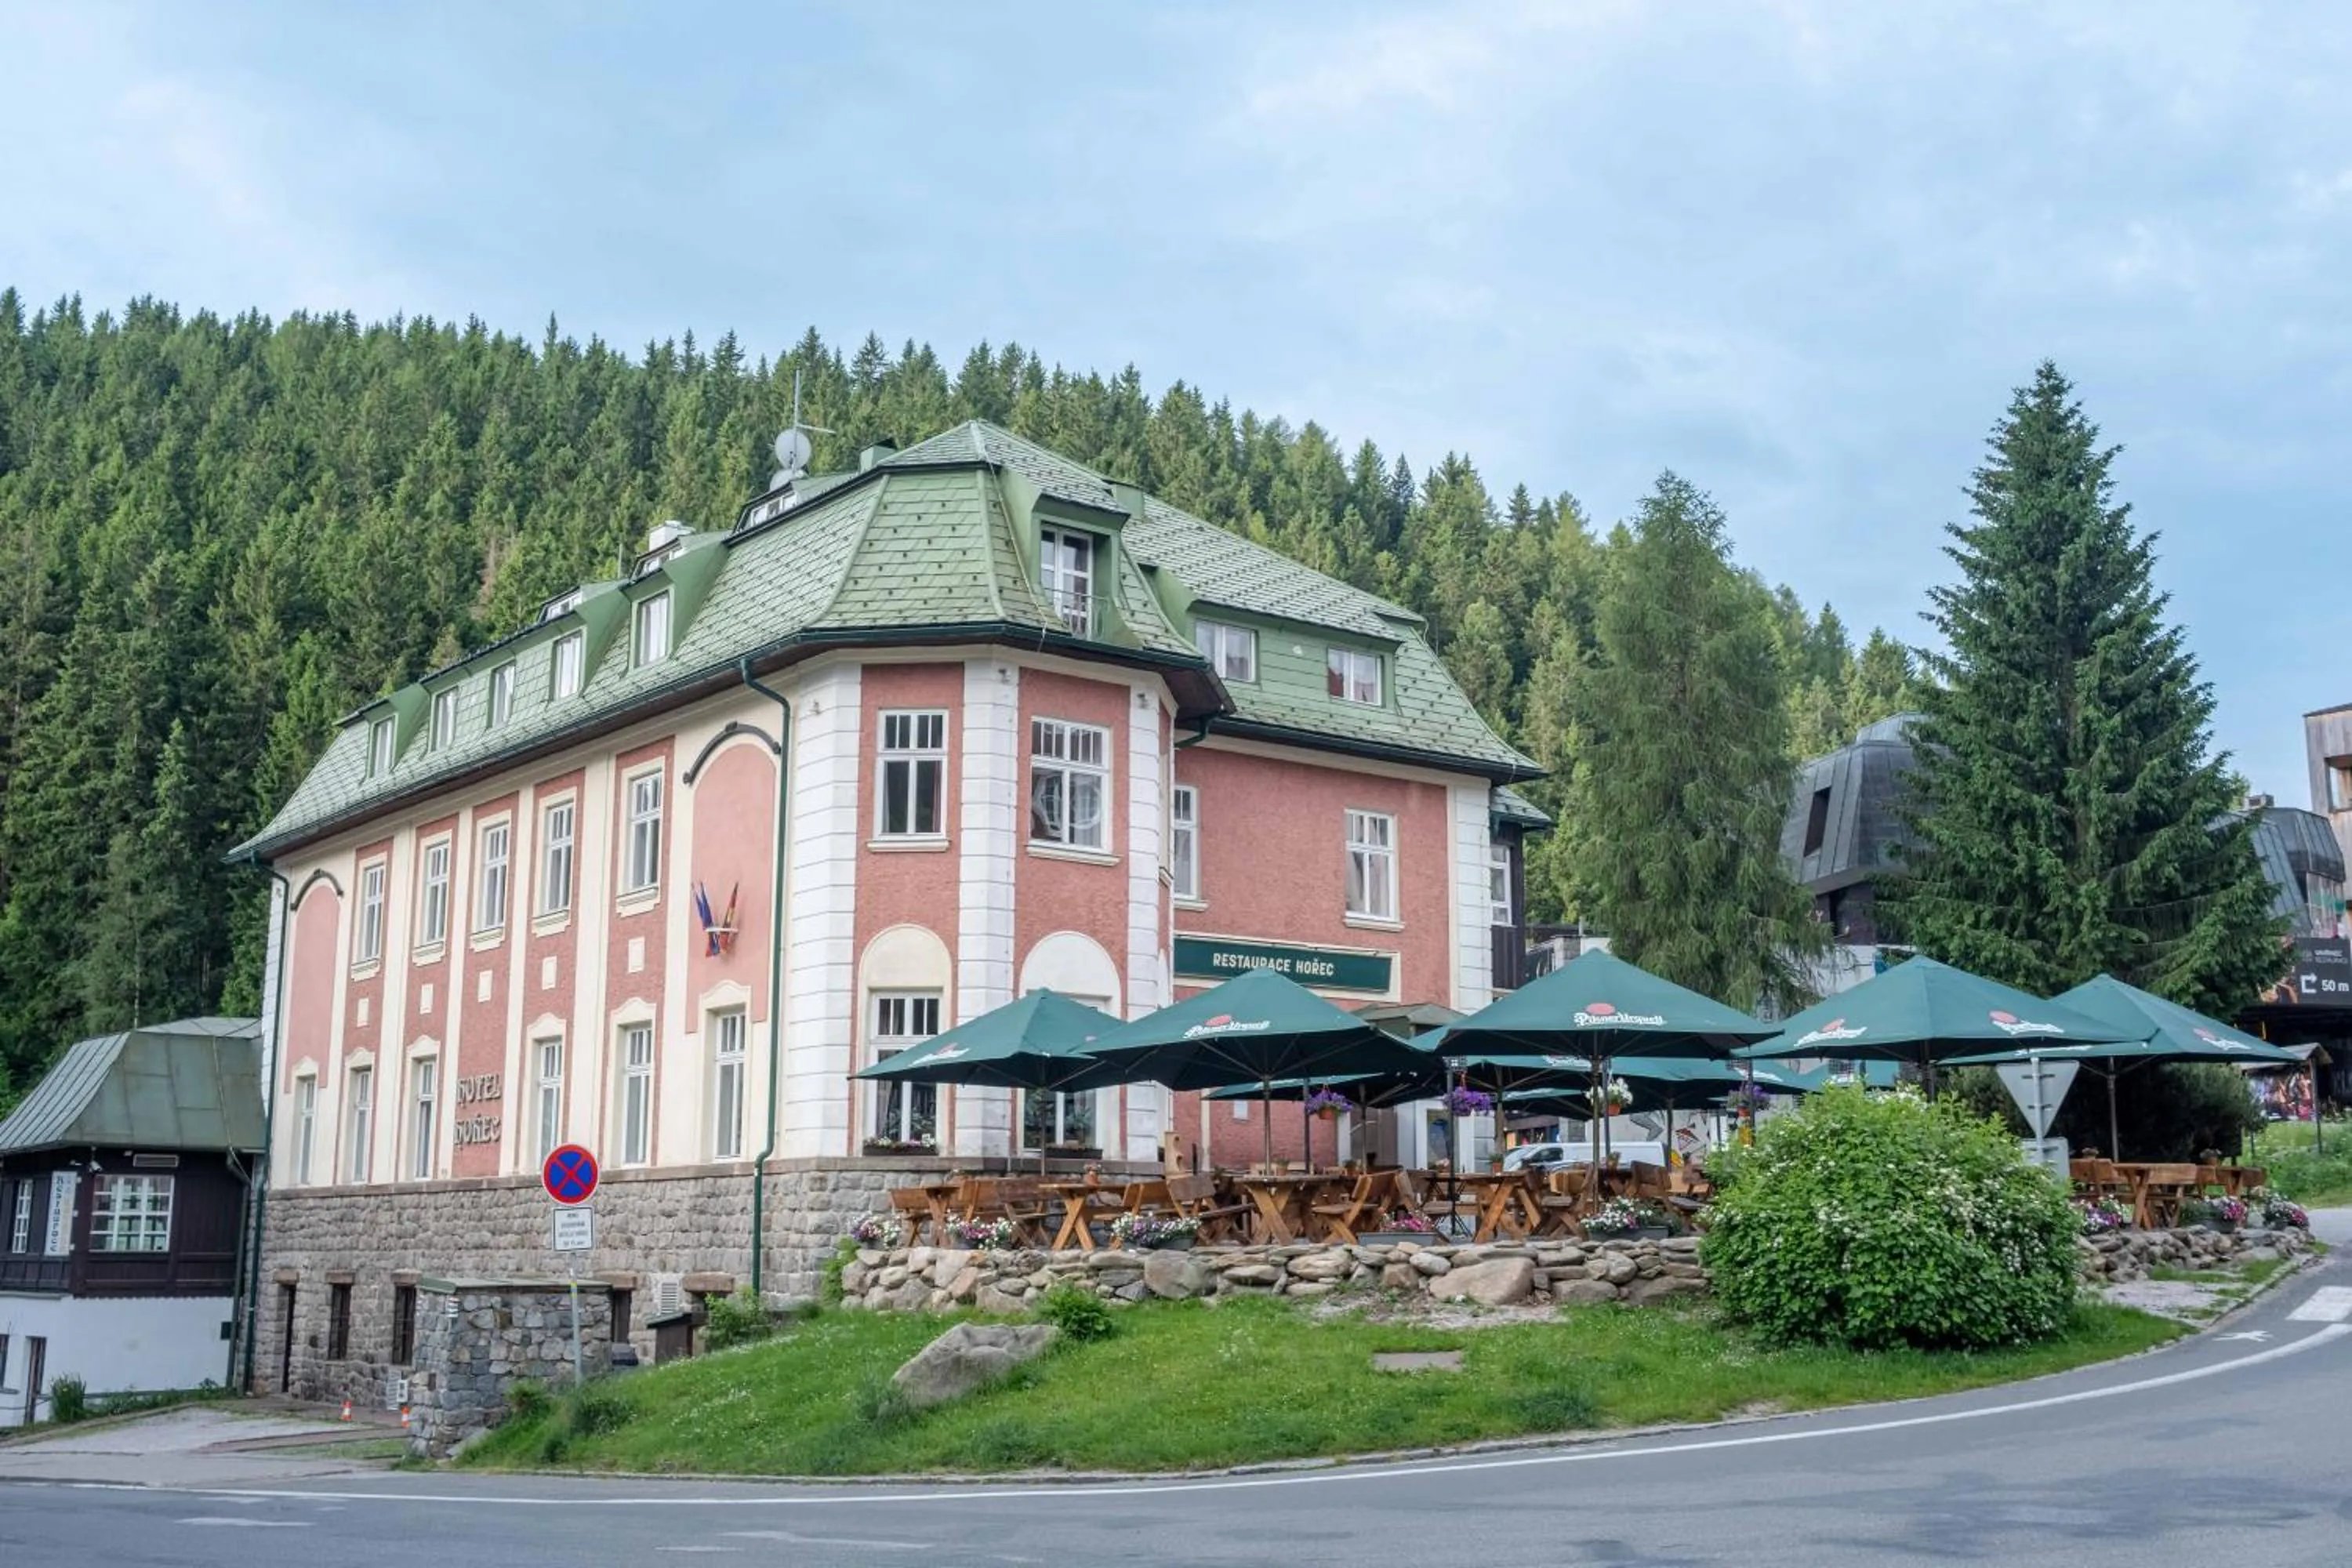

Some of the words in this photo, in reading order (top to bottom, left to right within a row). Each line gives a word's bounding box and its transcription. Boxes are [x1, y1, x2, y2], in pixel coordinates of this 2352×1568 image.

[1296, 958, 1334, 976] HOŘEC
[2321, 979, 2336, 992] 50
[2338, 982, 2350, 992] m
